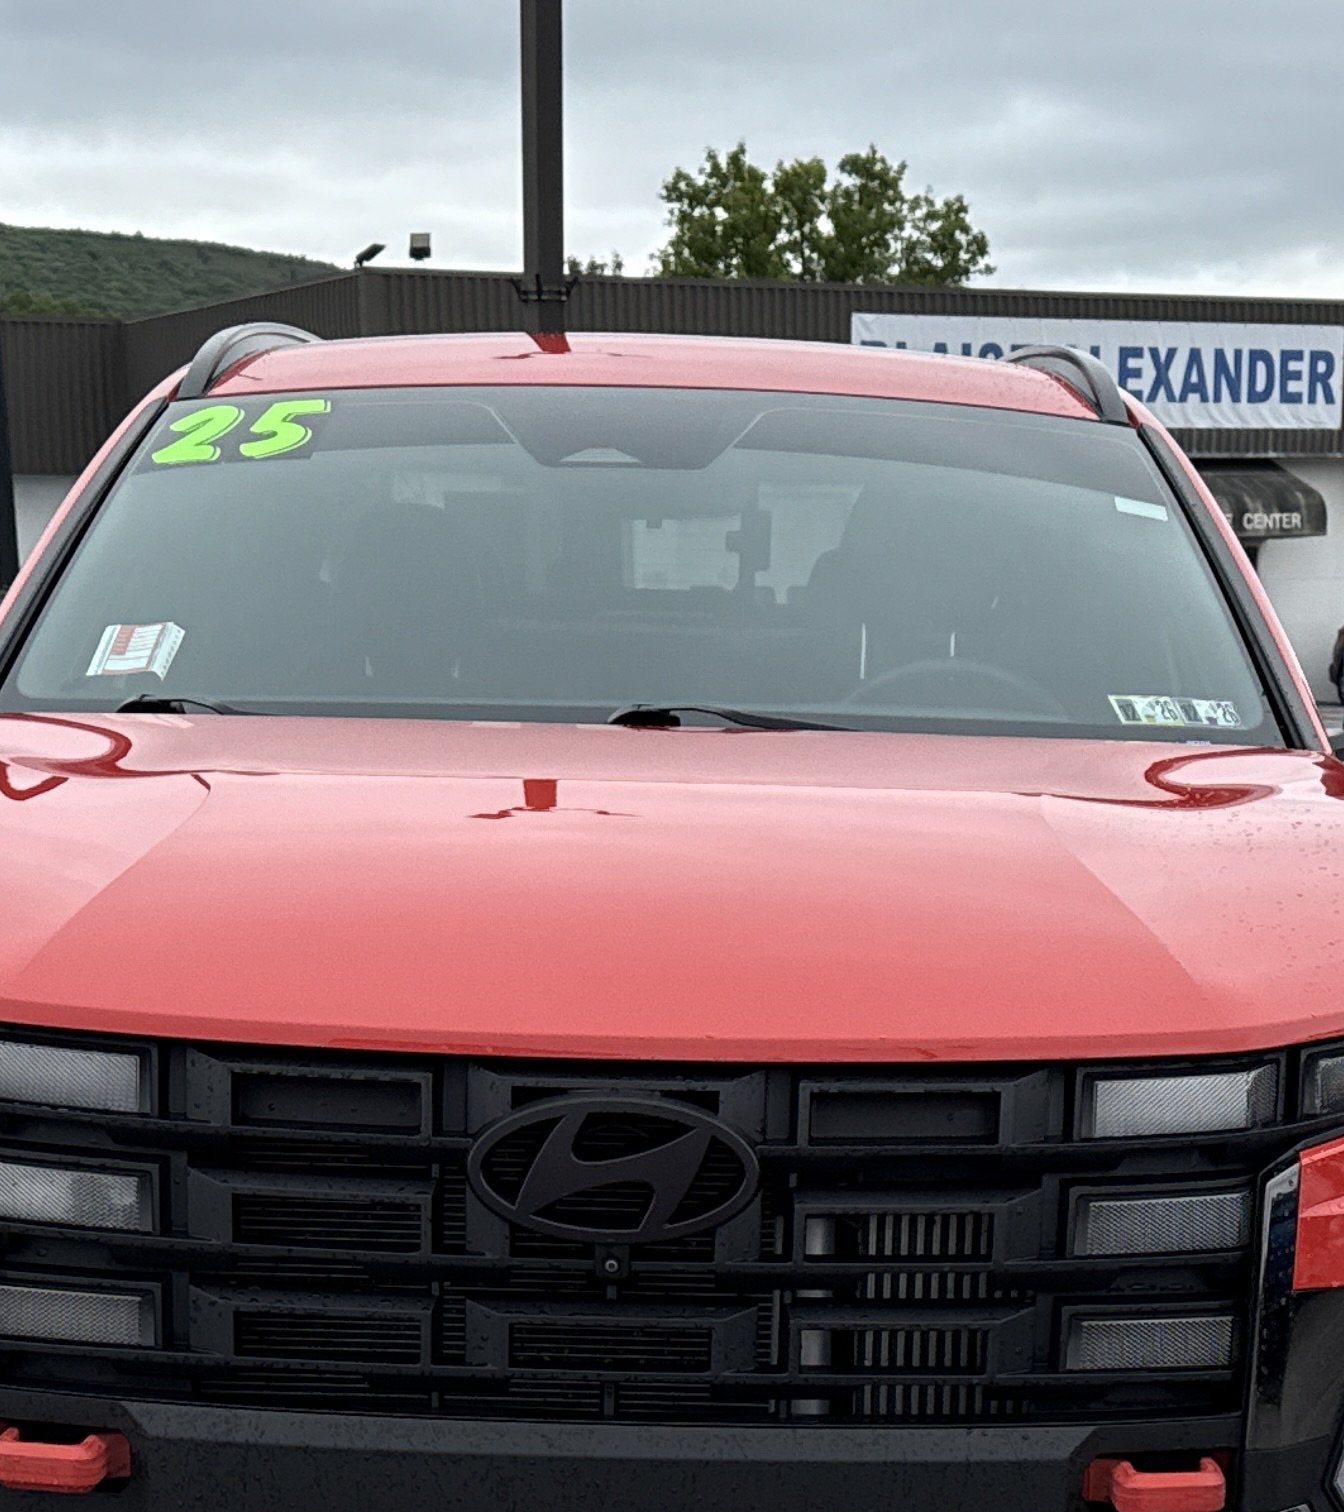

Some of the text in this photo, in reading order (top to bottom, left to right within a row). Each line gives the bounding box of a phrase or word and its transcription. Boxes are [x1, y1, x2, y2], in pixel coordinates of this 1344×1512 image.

[1068, 344, 1337, 405] EXANDER
[151, 399, 331, 464] 25
[1242, 512, 1302, 530] CENTER
[1154, 699, 1179, 721] 26
[1215, 702, 1240, 723] 26
